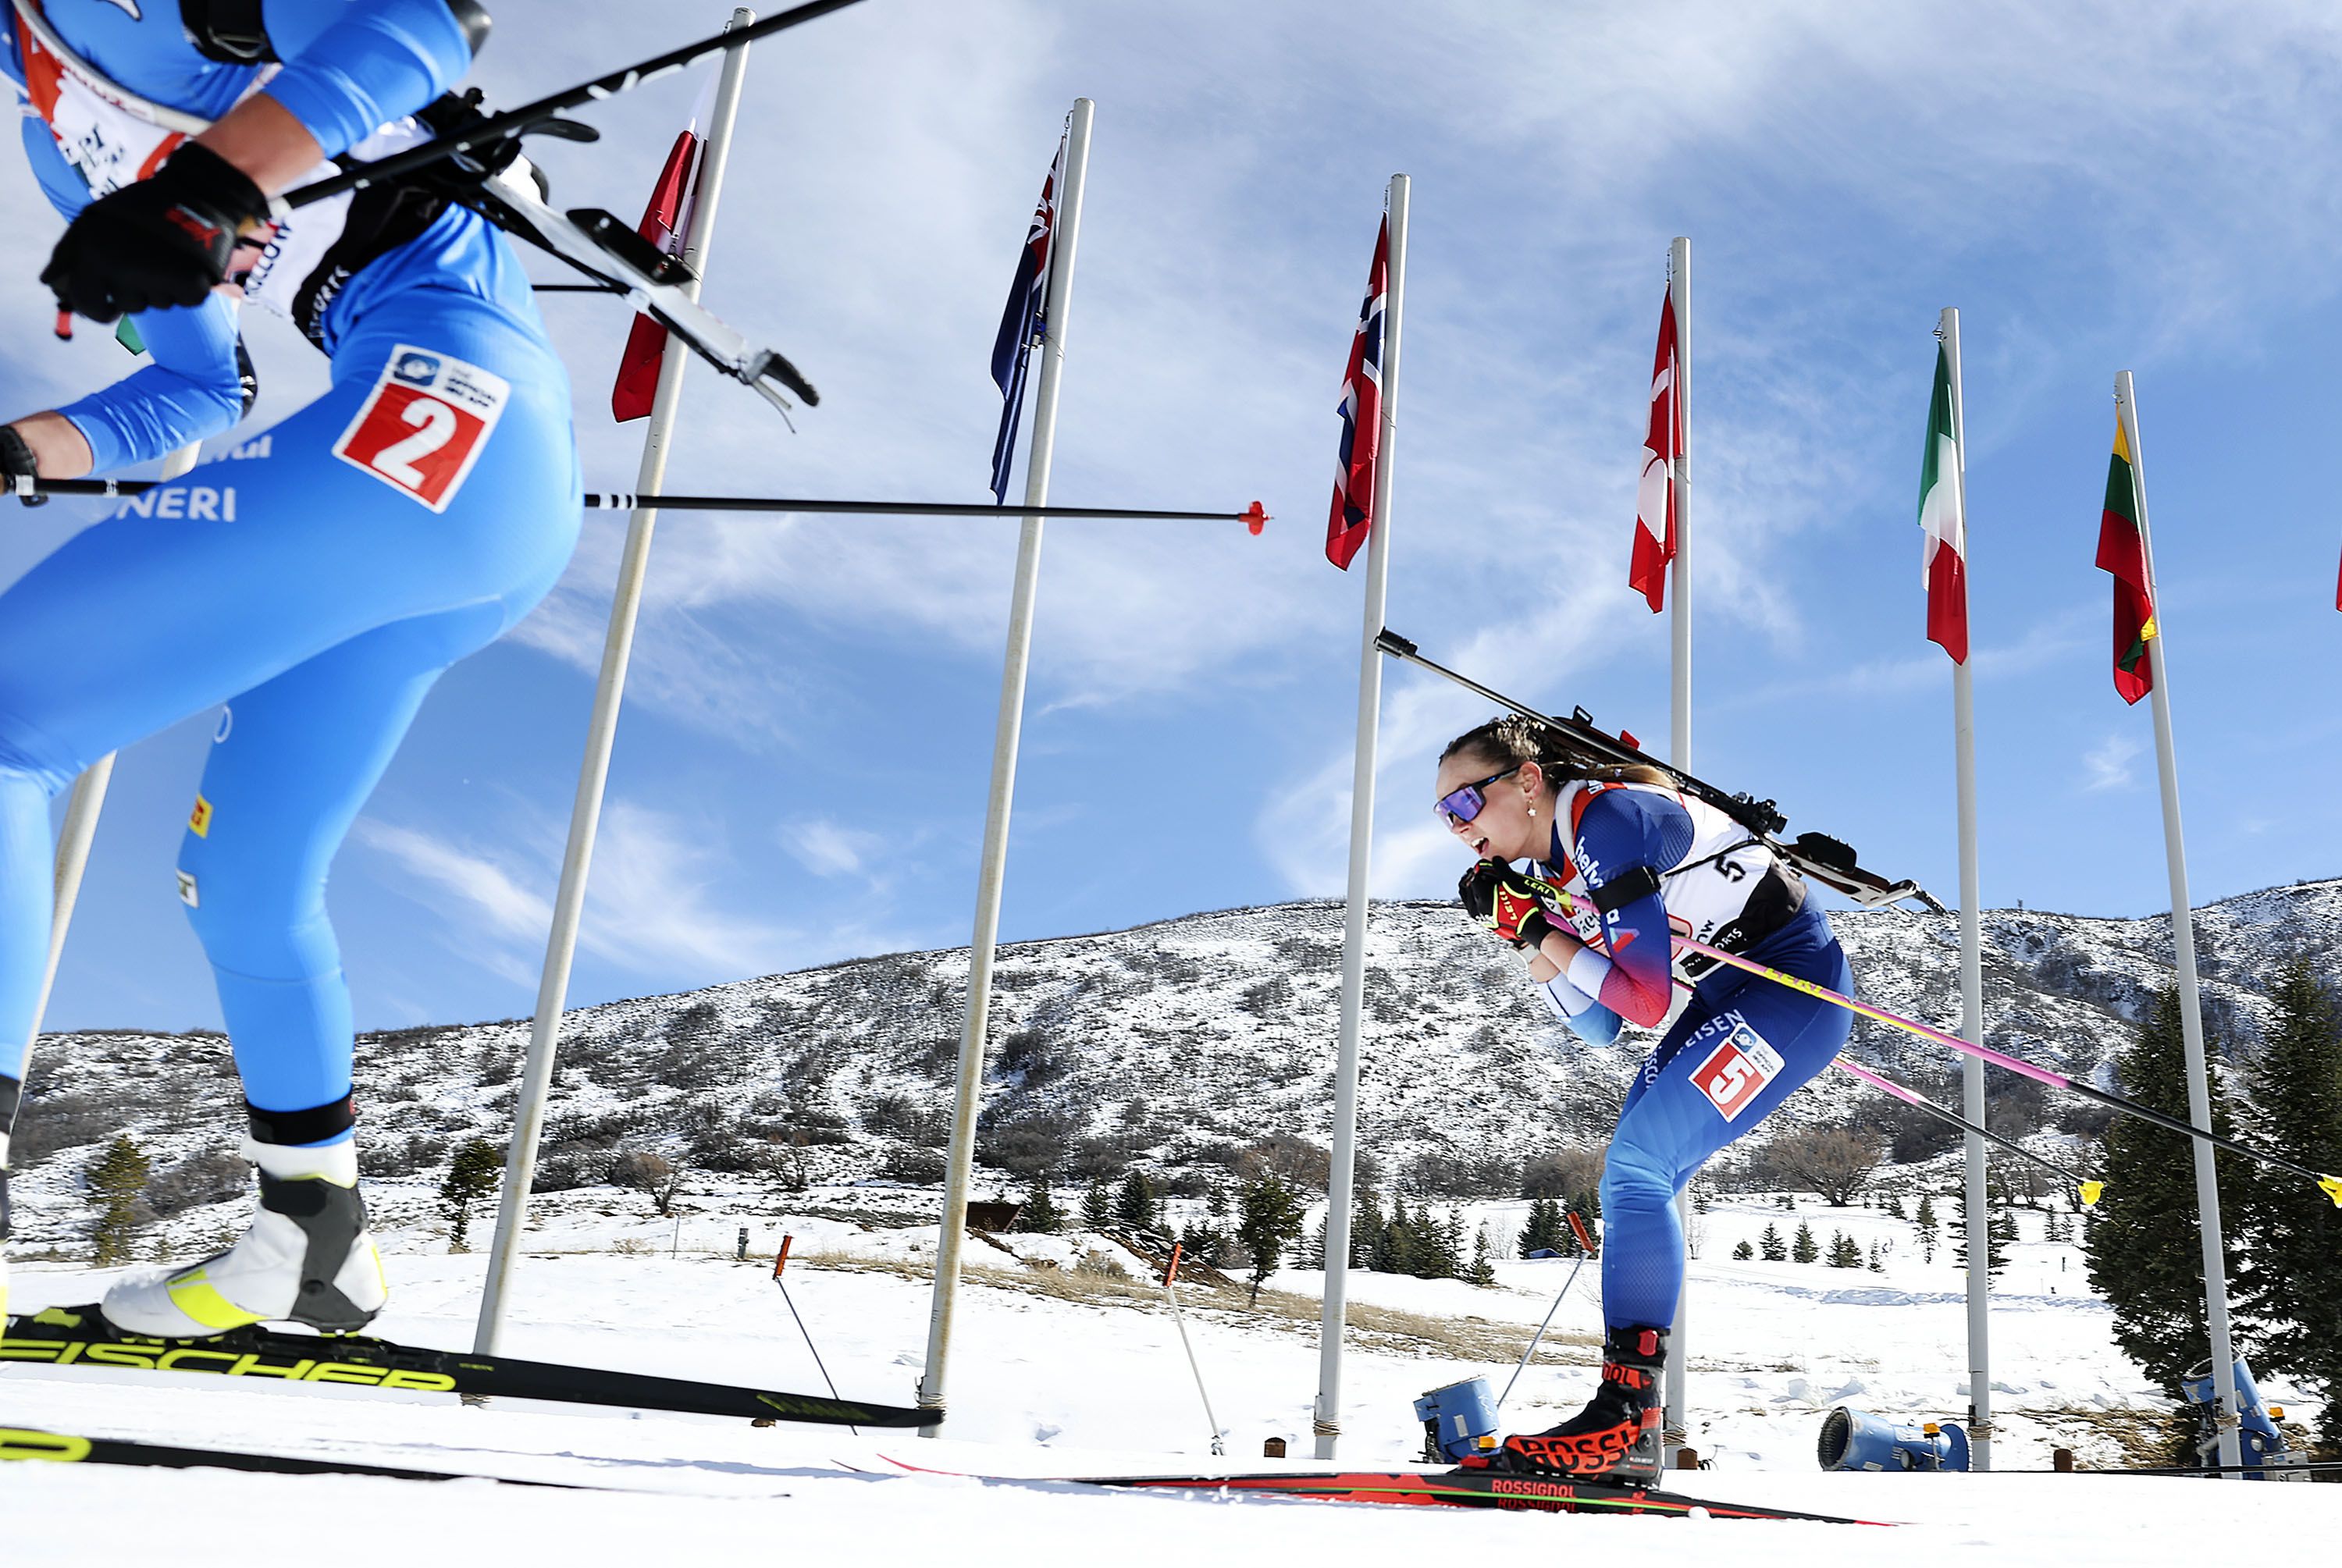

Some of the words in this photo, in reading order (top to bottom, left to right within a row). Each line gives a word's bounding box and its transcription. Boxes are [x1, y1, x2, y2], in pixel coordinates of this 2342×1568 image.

[370, 396, 457, 491] 2
[1714, 855, 1746, 883] 5
[1524, 880, 1551, 896] LEKI
[1764, 967, 1824, 997] LEKI
[1709, 1054, 1756, 1105] 5
[1491, 1479, 1577, 1499] ROSSIGNOL
